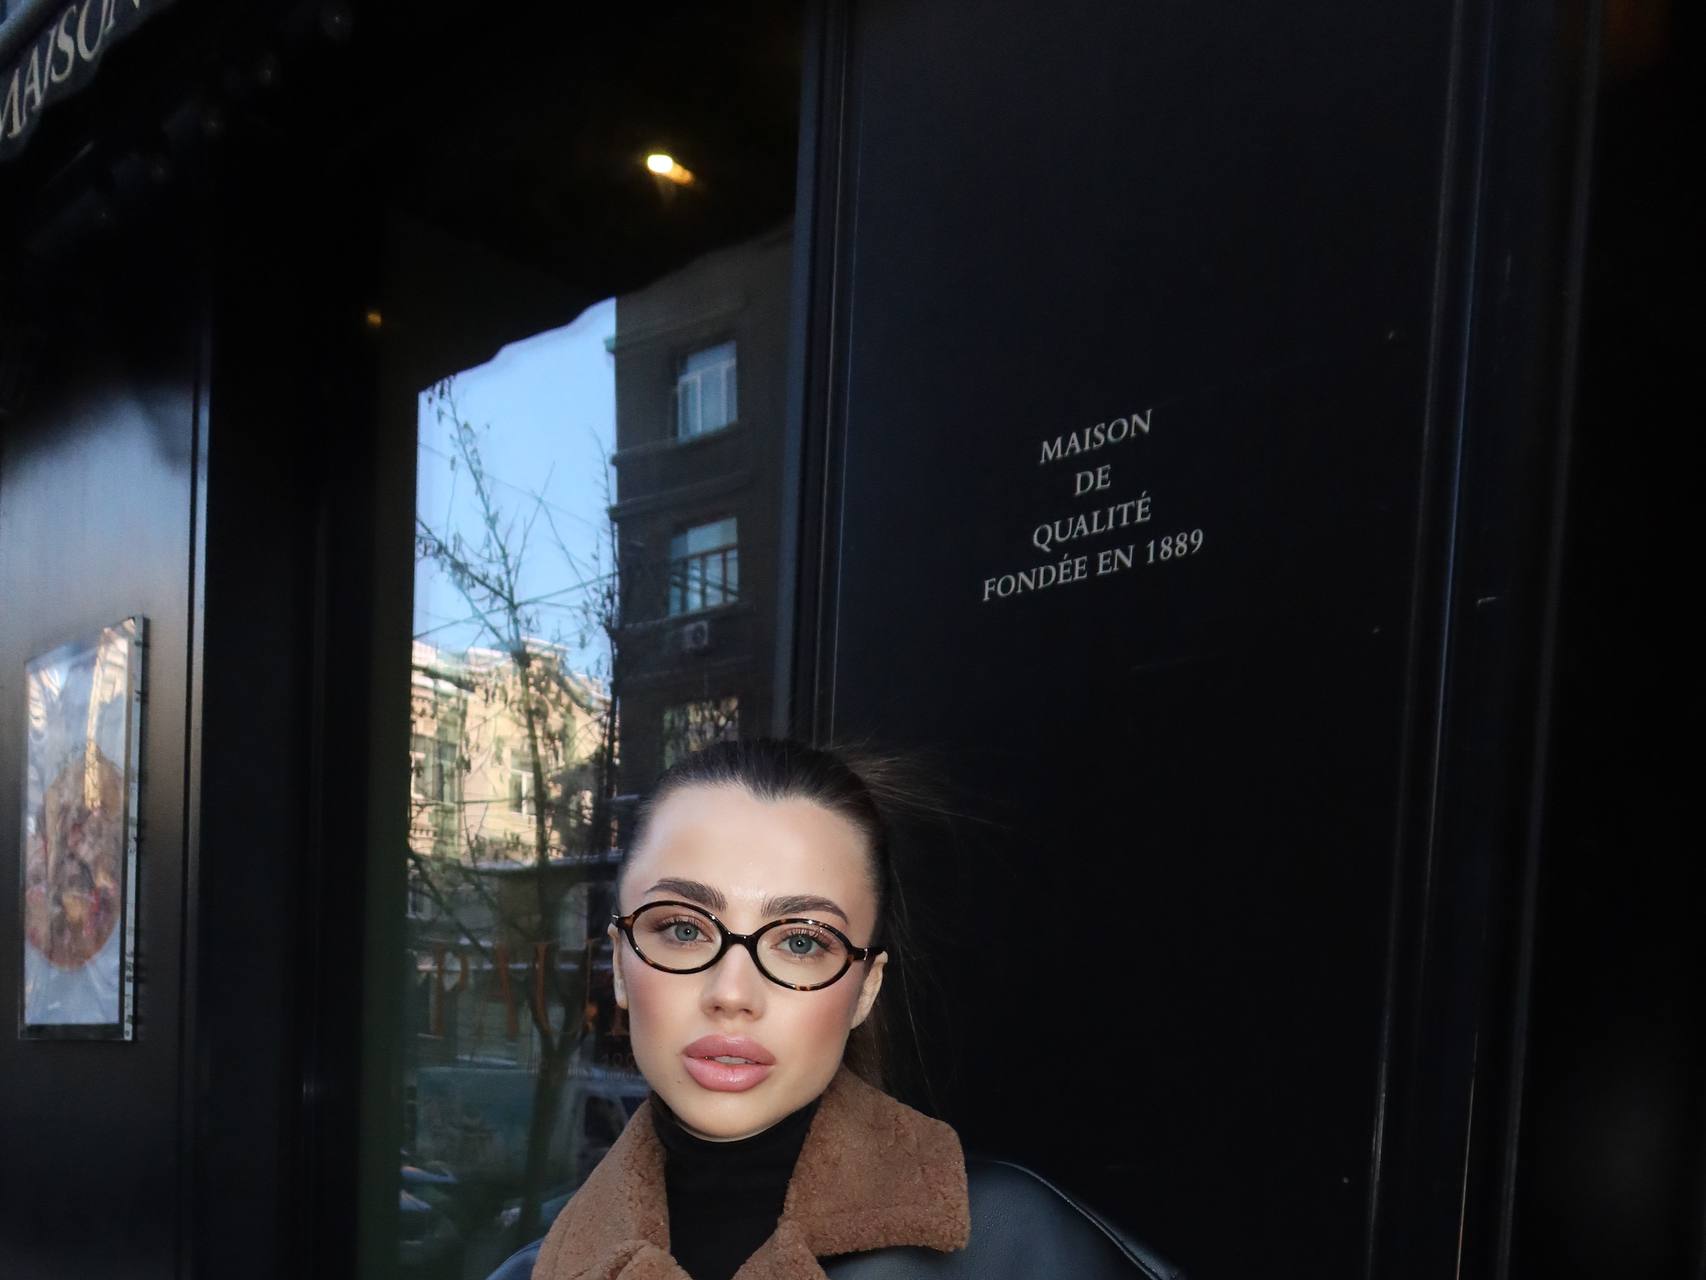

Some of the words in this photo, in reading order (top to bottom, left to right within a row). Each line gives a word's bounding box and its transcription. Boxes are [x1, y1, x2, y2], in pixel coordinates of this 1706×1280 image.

[1039, 409, 1153, 465] MAISON
[1074, 464, 1112, 496] DE
[1032, 490, 1153, 553] QUALITÉ
[982, 553, 1088, 601] FONDÉE
[1096, 545, 1136, 576] EN
[1146, 528, 1205, 565] 1889
